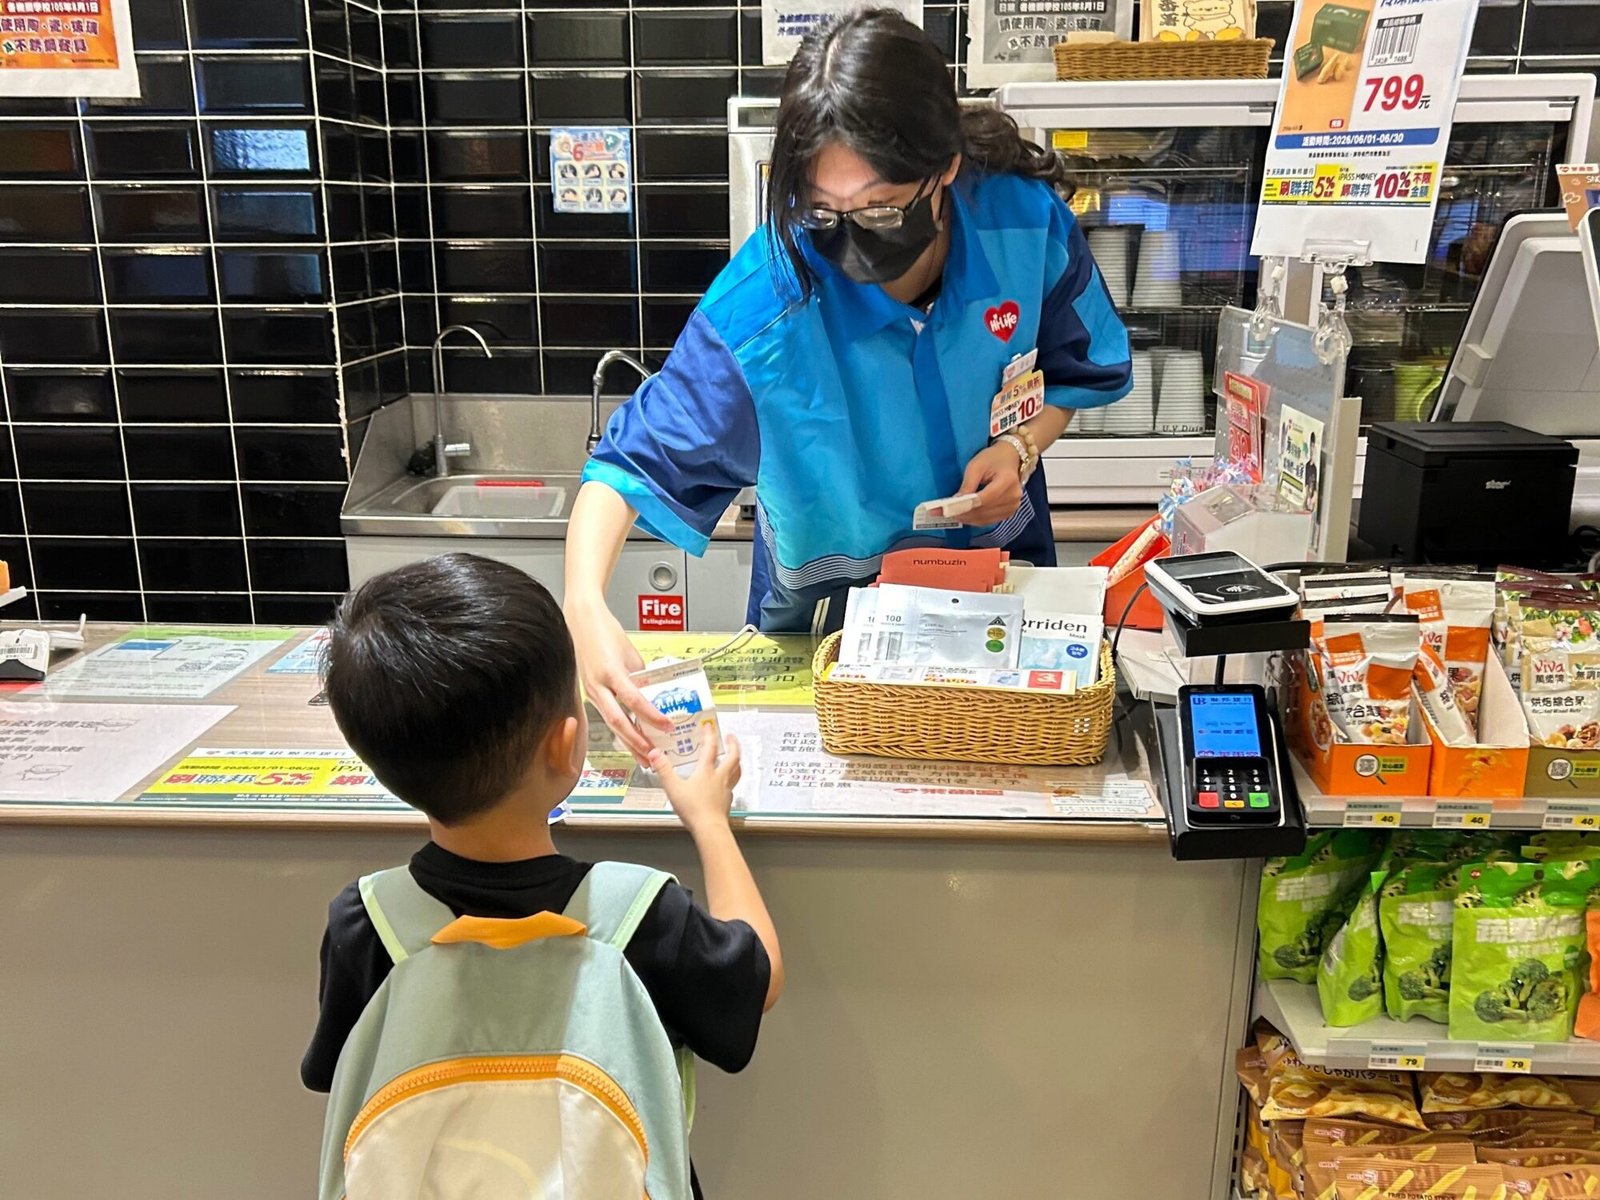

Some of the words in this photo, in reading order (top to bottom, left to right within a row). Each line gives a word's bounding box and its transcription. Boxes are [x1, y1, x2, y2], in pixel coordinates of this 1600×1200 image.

[1363, 74, 1425, 112] 799
[1418, 95, 1431, 109] 元
[1313, 176, 1336, 198] 5%
[1374, 171, 1411, 198] 10%
[1413, 172, 1433, 184] 不限
[1410, 186, 1429, 198] 金額
[641, 599, 681, 616] Fire
[642, 618, 682, 626] Extinguisher
[1535, 660, 1565, 673] Viva
[254, 772, 312, 787] 5%
